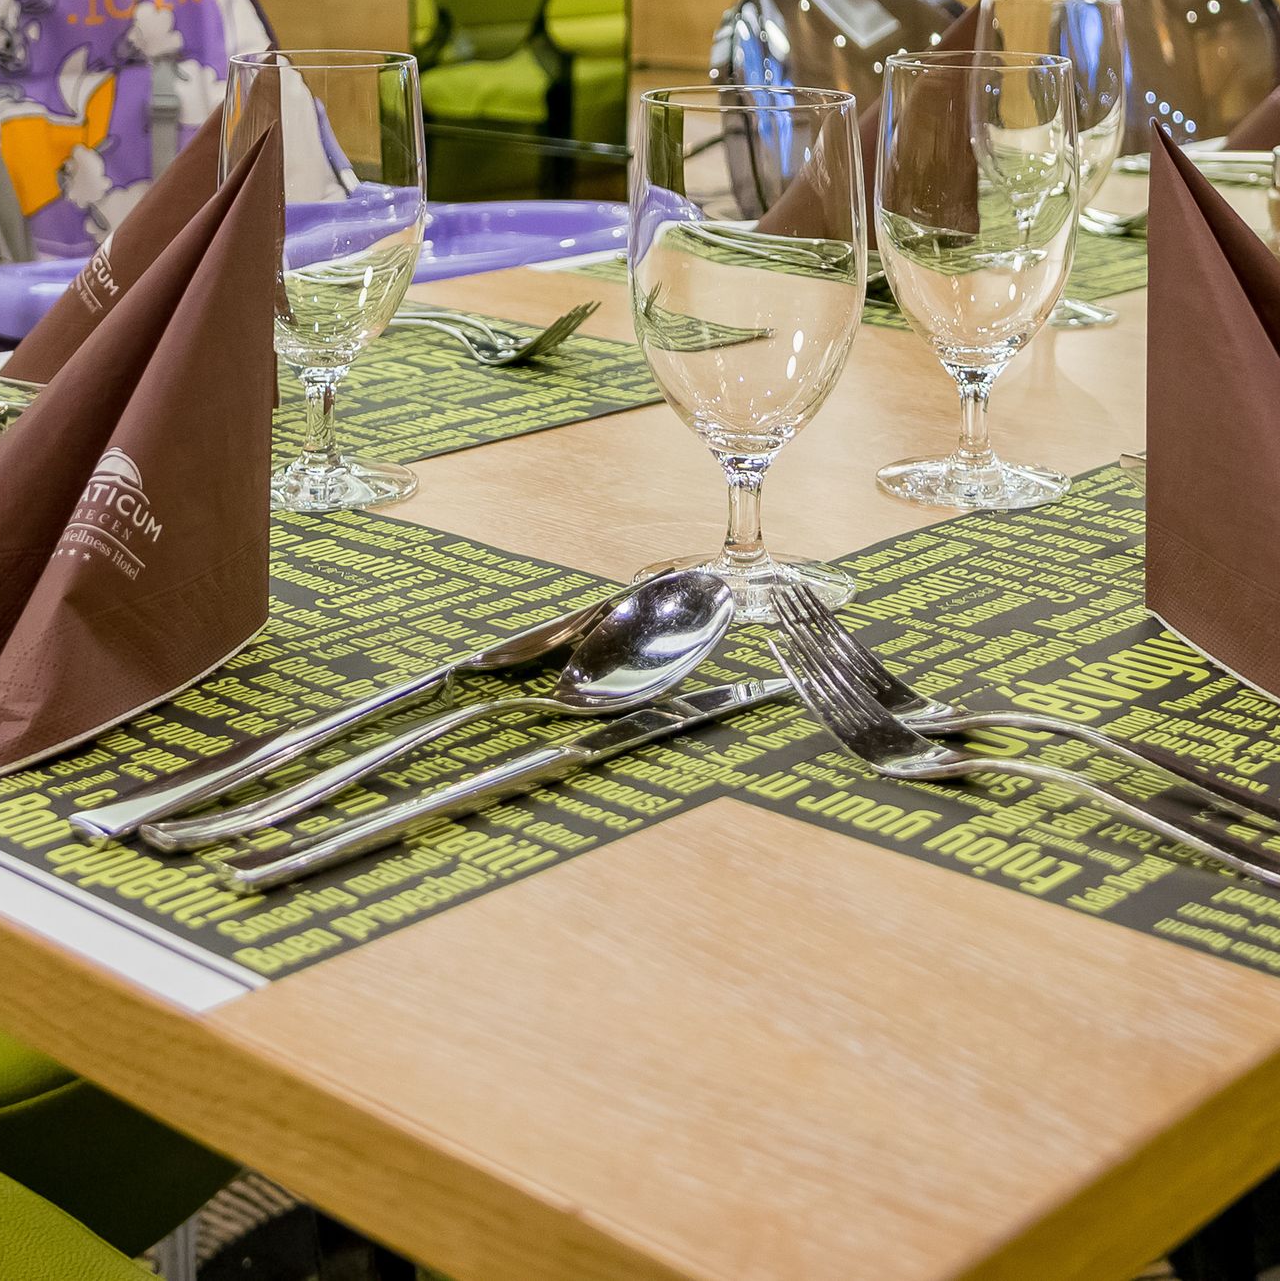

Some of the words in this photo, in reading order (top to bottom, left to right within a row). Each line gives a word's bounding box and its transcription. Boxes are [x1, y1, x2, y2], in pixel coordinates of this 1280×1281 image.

[954, 517, 1034, 537] apetit!
[1032, 505, 1083, 520] tek!
[304, 516, 418, 551] provecho!
[932, 524, 1018, 549] Appetit!
[1028, 533, 1105, 555] Dobar
[112, 550, 140, 580] Hotel
[284, 538, 427, 584] Appetit!
[399, 544, 539, 588] Smacznego!
[851, 537, 977, 584] Smacznego!
[958, 556, 1034, 578] olsun!
[981, 549, 1090, 579] аппетита!
[1013, 543, 1081, 563] Guten
[314, 567, 446, 609] Смачного!
[338, 595, 414, 620] Afiyet
[405, 576, 475, 601] olsun!
[453, 596, 524, 619] Guten
[510, 573, 595, 603] Appetit!
[841, 571, 976, 621] Appetit!
[931, 565, 1078, 605] Смачного!
[1028, 571, 1102, 596] Afiyet
[282, 615, 401, 652] Приятного
[399, 586, 497, 619] аппетита!
[485, 605, 562, 631] Dobar
[936, 589, 1035, 629] Skanaus!
[309, 643, 358, 661] Kali
[350, 625, 417, 649] Orexi!
[395, 634, 453, 660] Kale
[871, 628, 934, 656] anaus!
[963, 629, 1044, 664] apetite!
[267, 655, 348, 687] Guten
[975, 637, 1082, 687] provecho!
[1154, 717, 1249, 752] Bună!
[1197, 708, 1269, 732] eten!
[379, 753, 465, 789] Poftă
[448, 728, 535, 763] Bună!
[703, 741, 767, 770] Kali
[746, 717, 823, 750] Orexi!
[48, 748, 117, 778] eten!
[791, 761, 856, 788] Prijatn
[47, 770, 118, 796] Prijatno!
[795, 779, 943, 840] your
[522, 820, 597, 851] eten!
[922, 821, 1083, 895] Enjoy
[46, 836, 266, 928] appétit!
[233, 928, 342, 974] Buen
[330, 859, 497, 940] provecho!
